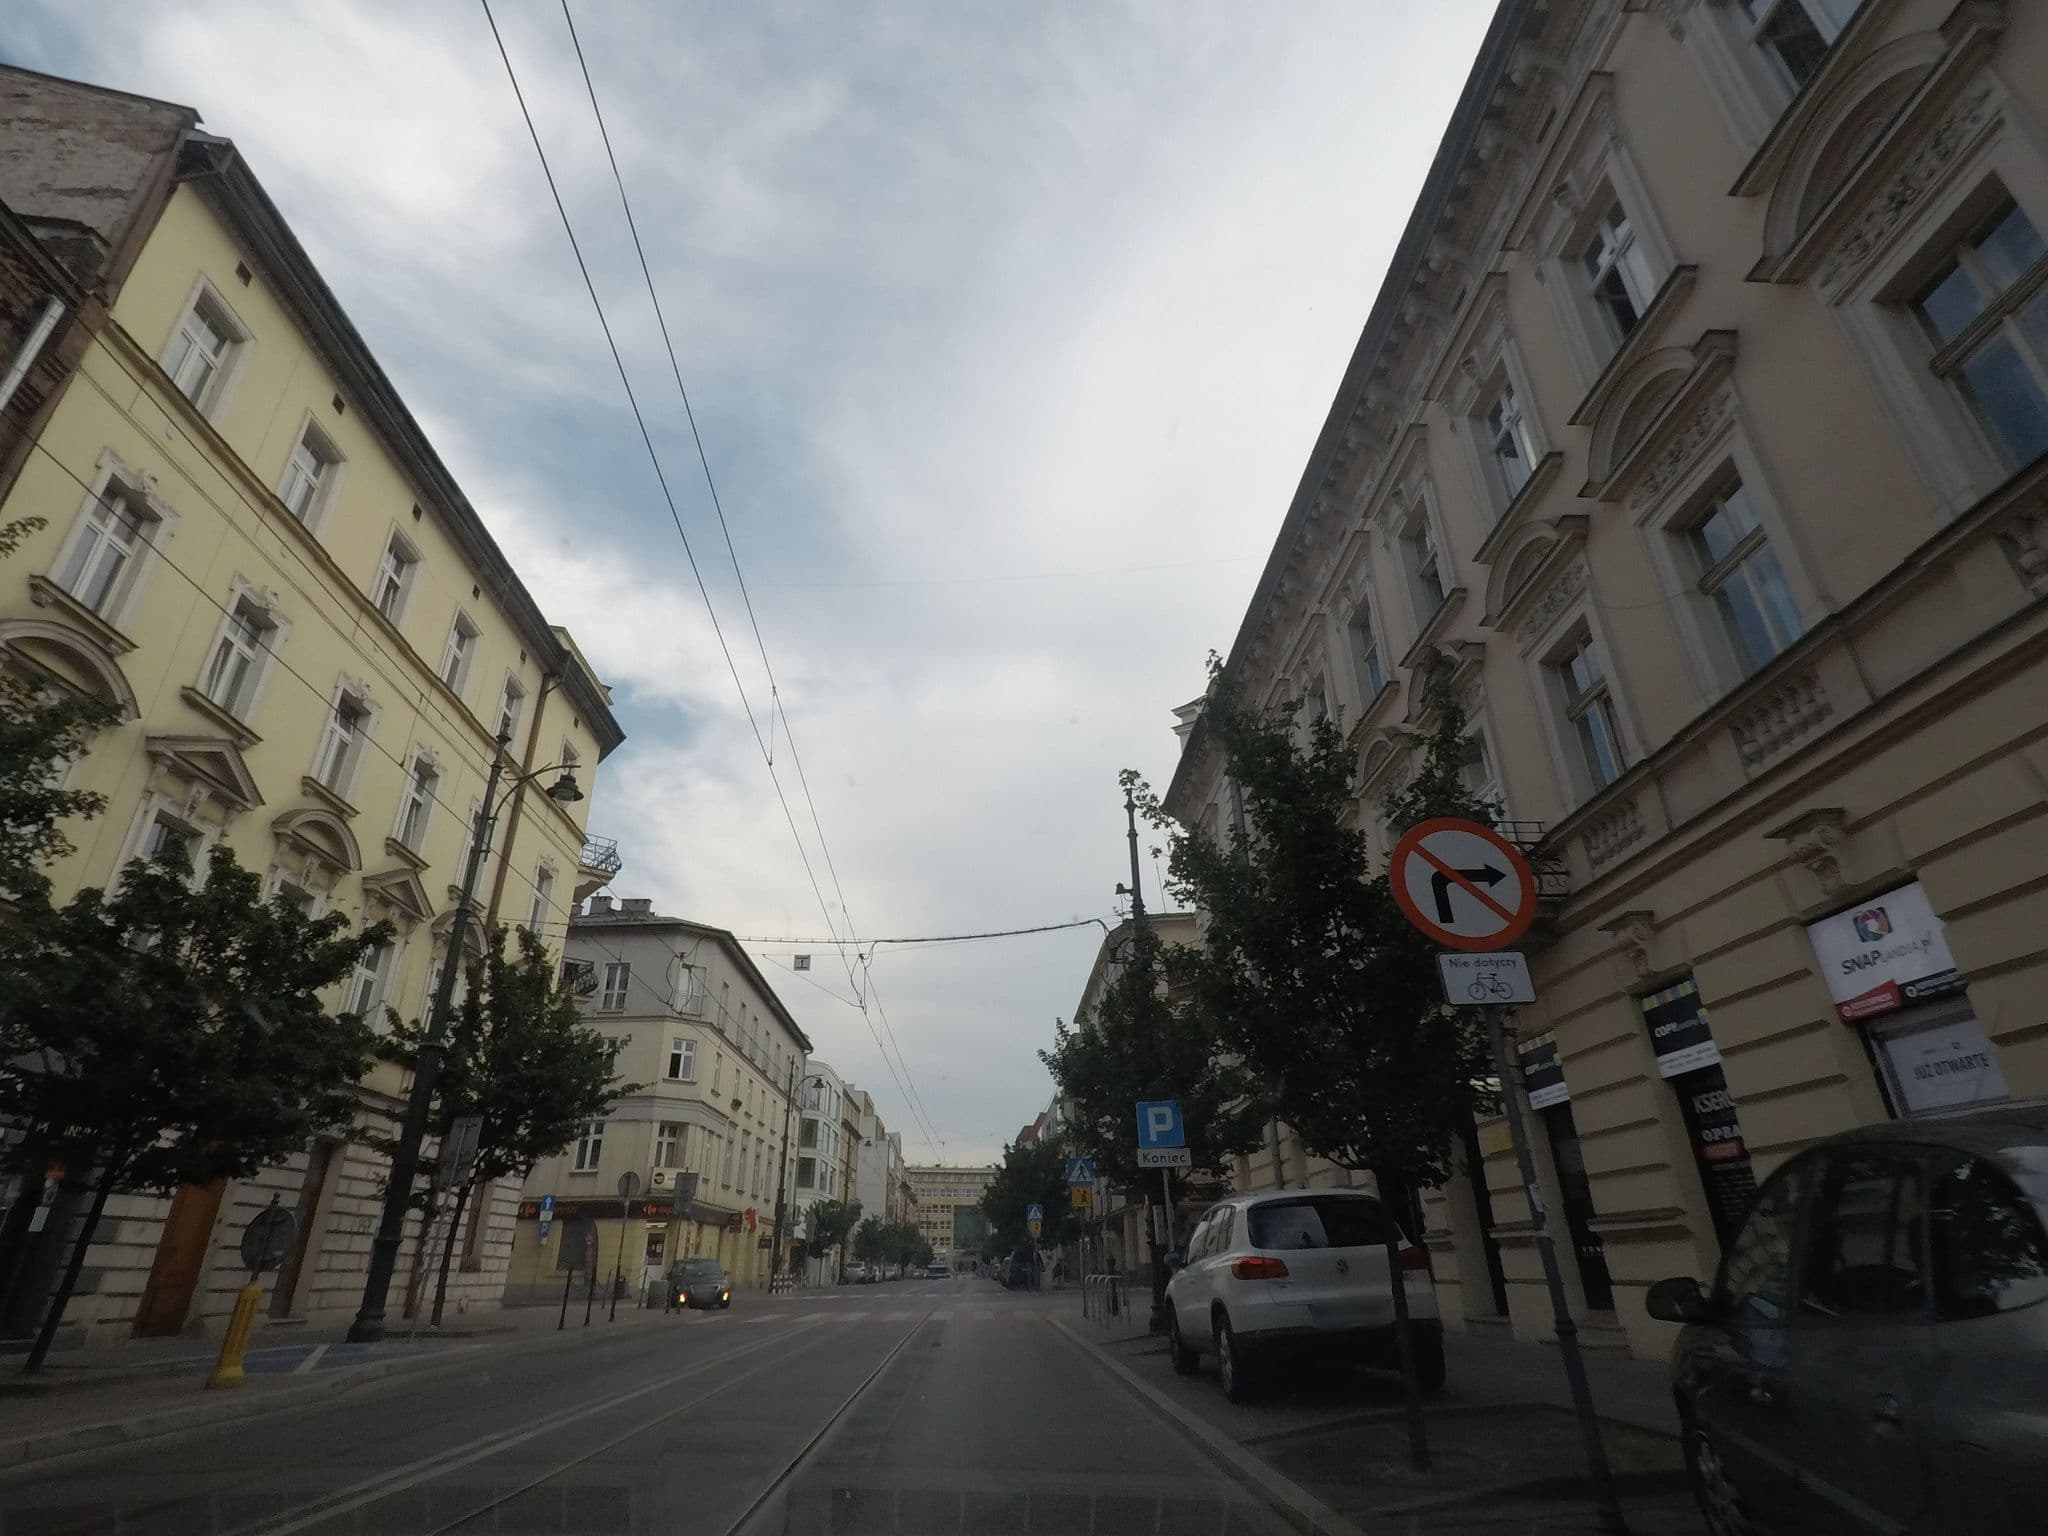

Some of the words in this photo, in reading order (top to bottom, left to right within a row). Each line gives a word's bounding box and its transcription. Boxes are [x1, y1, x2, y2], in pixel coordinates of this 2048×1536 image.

[1448, 958, 1470, 969] Nie
[1474, 957, 1517, 969] dotyczy
[1935, 1053, 1990, 1077] OTWARTE
[1147, 1106, 1173, 1142] P
[1142, 1152, 1187, 1163] Koniec
